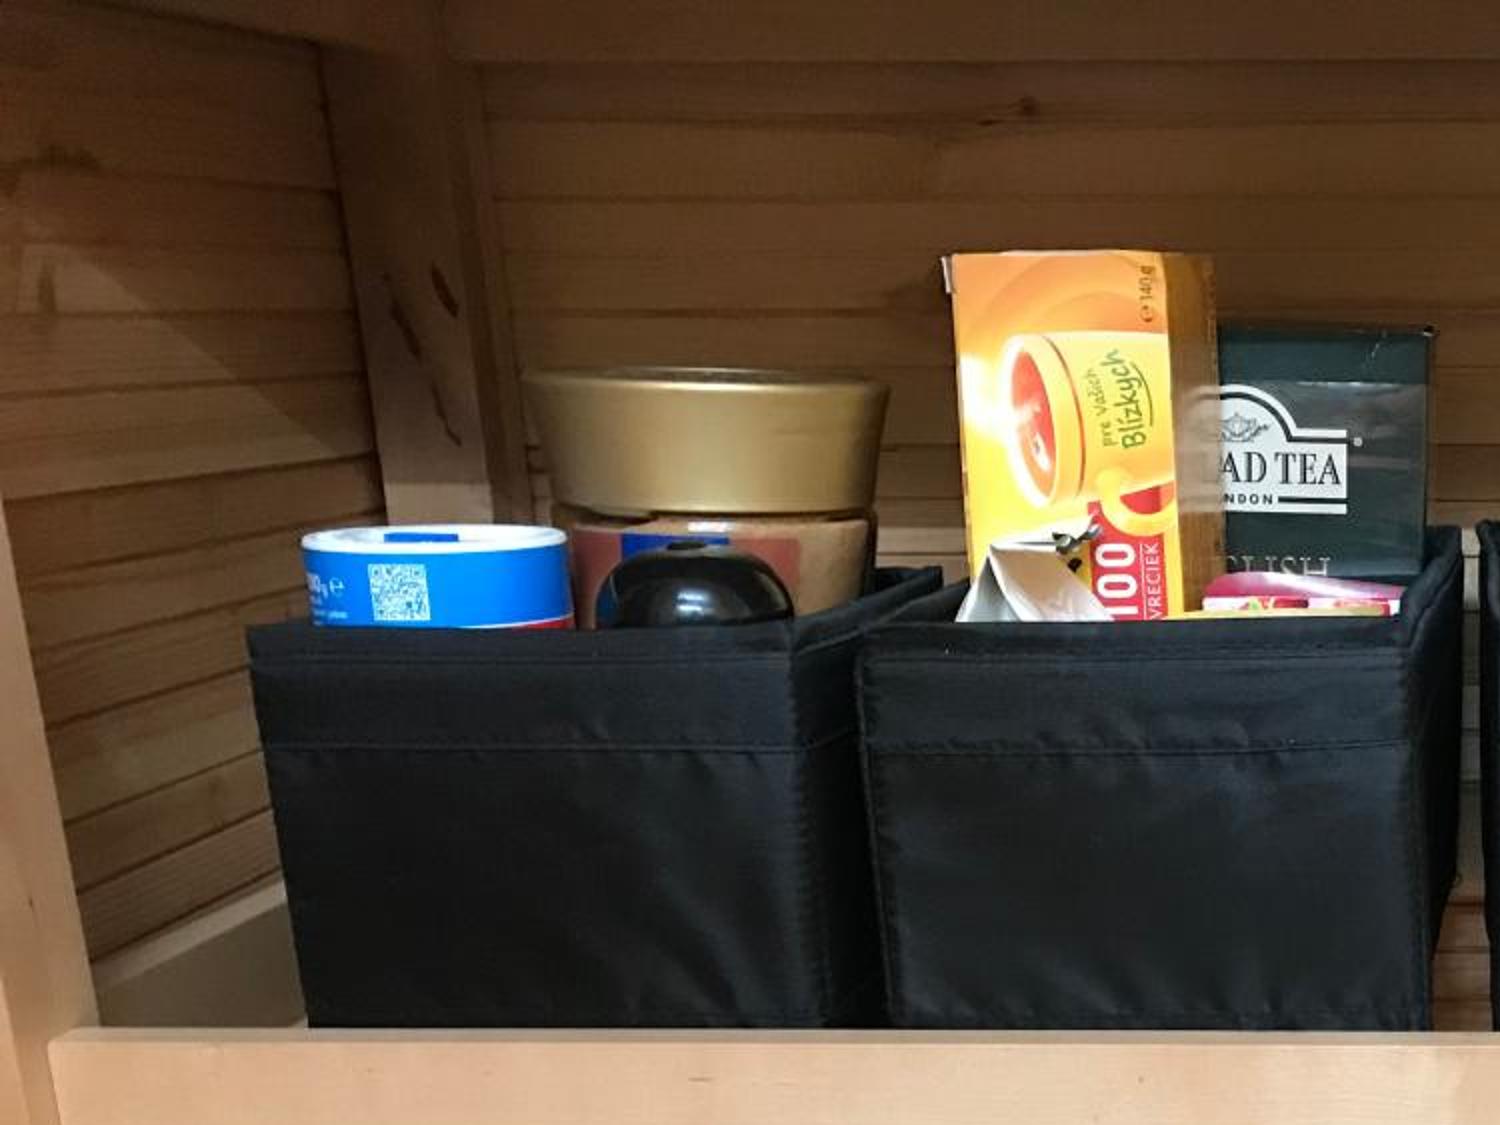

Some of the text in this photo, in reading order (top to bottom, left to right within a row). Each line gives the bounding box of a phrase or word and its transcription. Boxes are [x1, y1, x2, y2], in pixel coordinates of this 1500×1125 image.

[1100, 348, 1147, 449] Blízkych
[1101, 422, 1119, 447] pre
[1220, 451, 1341, 485] AD TEA
[1223, 493, 1274, 505] NDON
[1094, 542, 1139, 616] 100
[1142, 542, 1163, 619] VRECIEK
